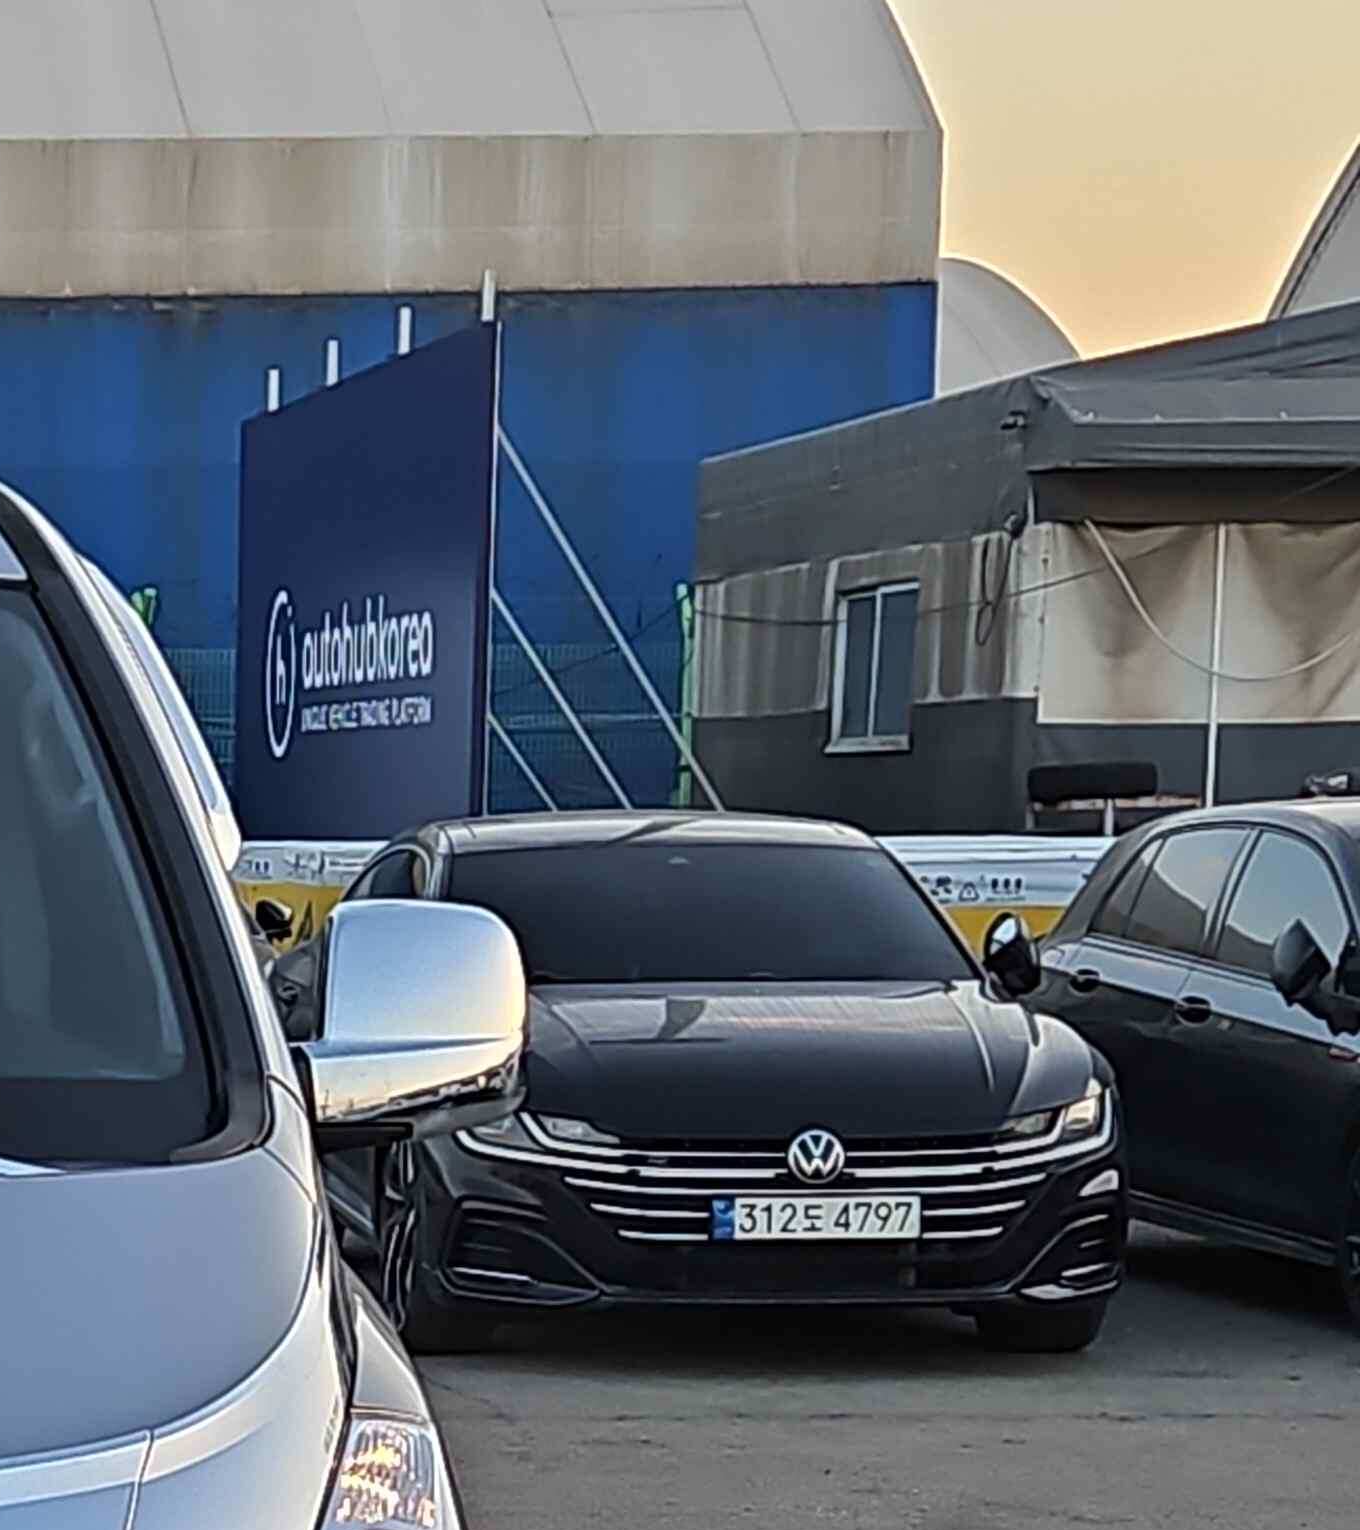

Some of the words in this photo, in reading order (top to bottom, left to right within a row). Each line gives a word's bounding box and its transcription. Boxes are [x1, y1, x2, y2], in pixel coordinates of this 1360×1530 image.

[302, 594, 433, 690] autohubkorea
[738, 1202, 825, 1233] 312도
[832, 1201, 914, 1233] 4797
